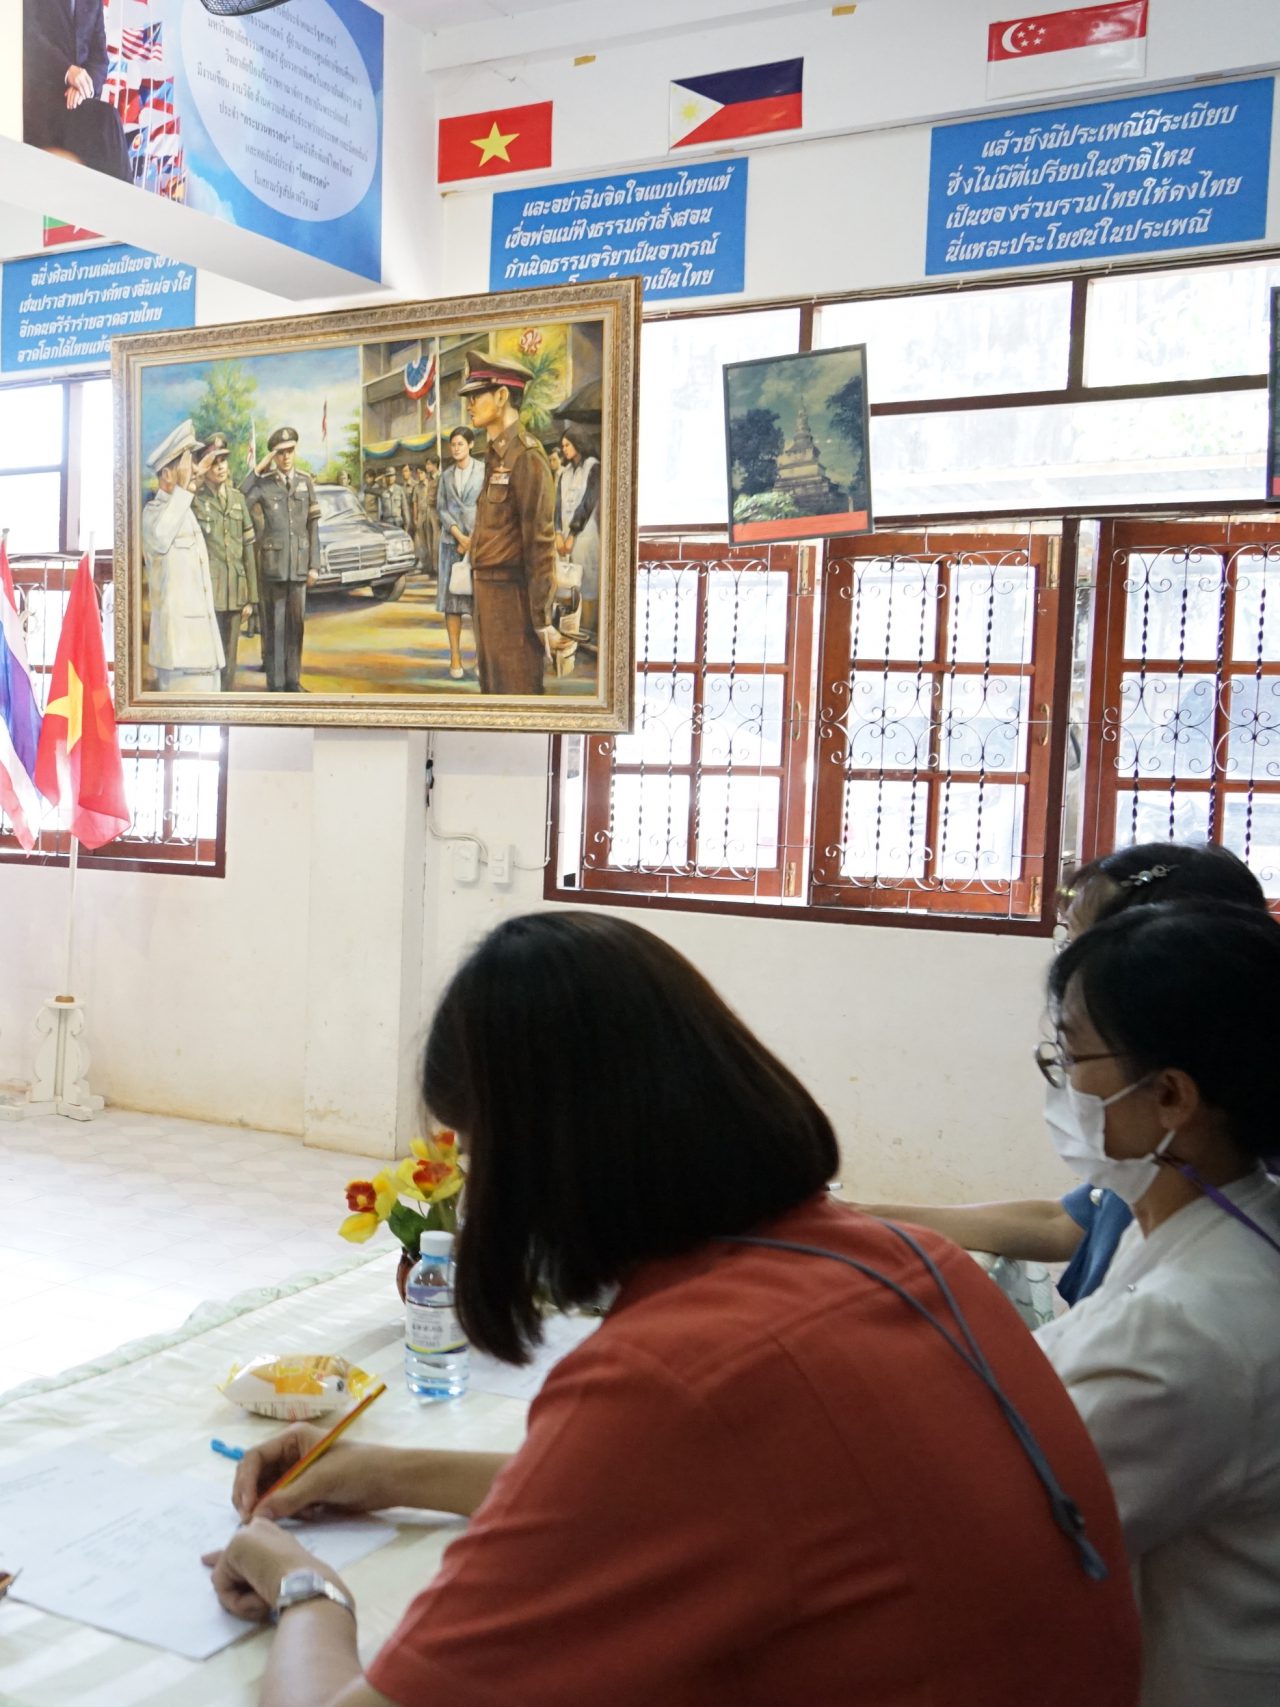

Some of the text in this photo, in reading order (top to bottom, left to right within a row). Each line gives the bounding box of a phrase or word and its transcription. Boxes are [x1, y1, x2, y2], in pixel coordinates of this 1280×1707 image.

[981, 100, 1240, 159] แล้วยังมีประเพณีมีระเบียบ
[523, 166, 735, 217] และอย่าลืมจิตใจแบบไทยแท้
[946, 141, 1197, 197] ซึ่งไม่มีที่เปรียบในชาติไหน
[504, 203, 713, 249] เชื่อพ่อแม่ฟังธรรมคำสั่งสอน
[945, 168, 1243, 230] เป็นของร่วมรวมไทยให้คงไทย
[504, 232, 721, 279] กำเนิดธรรมจริยาเป็นอาภรณ์
[944, 208, 1214, 263] นี่แหละประโยชน์ในประเพณี
